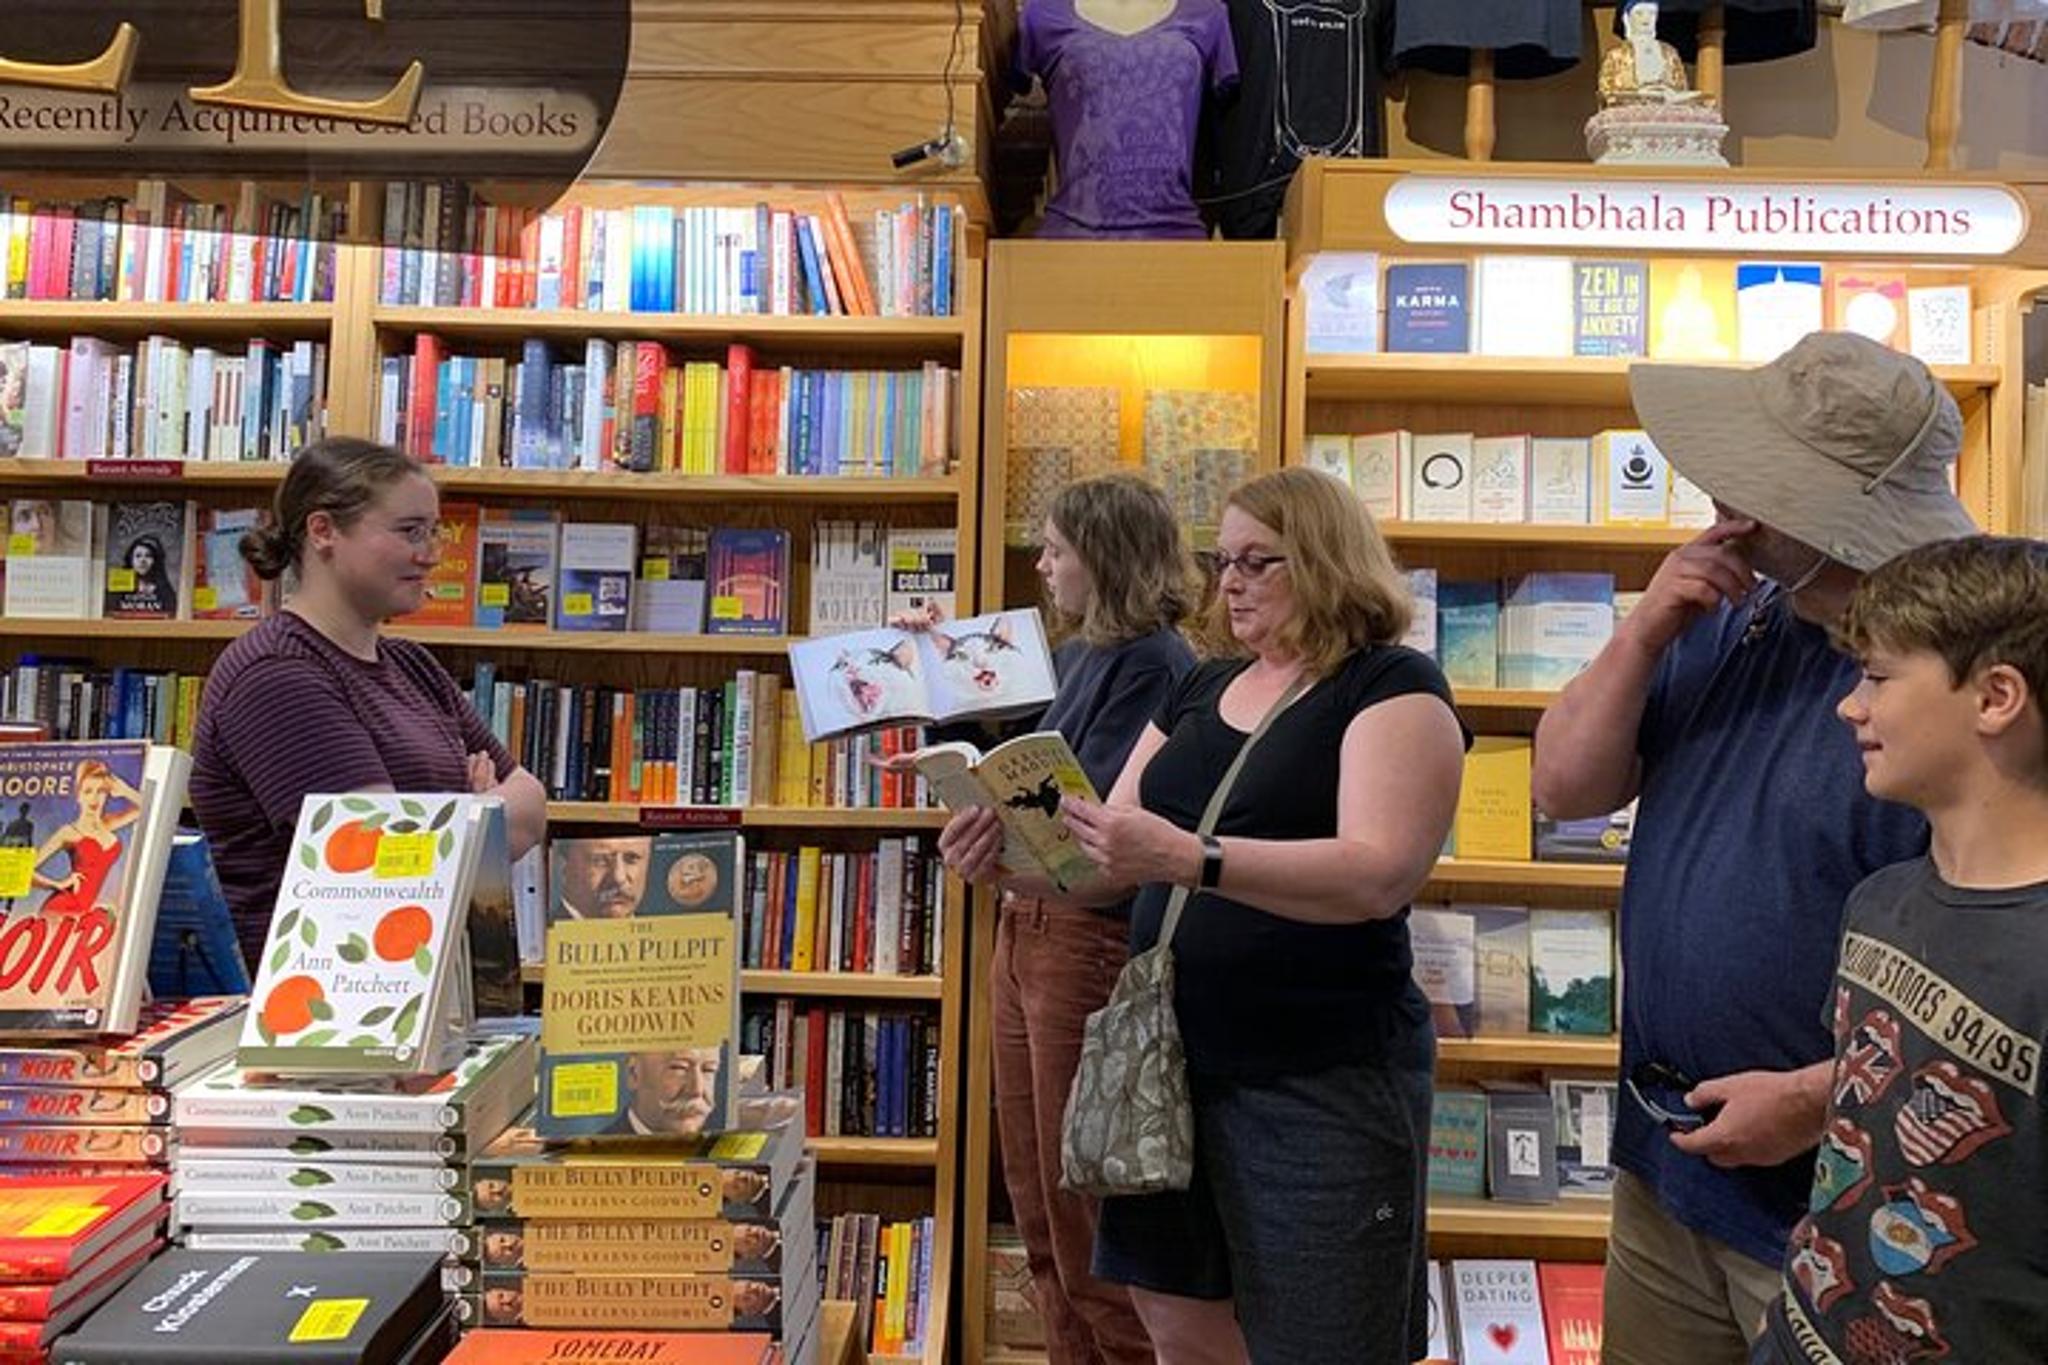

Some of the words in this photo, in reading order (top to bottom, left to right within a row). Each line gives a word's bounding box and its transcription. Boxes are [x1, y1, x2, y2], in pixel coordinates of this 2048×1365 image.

[0, 96, 148, 142] Recently
[463, 103, 577, 135] Books
[1450, 190, 1686, 231] Shambhala
[1706, 196, 1971, 236] Publications
[1581, 267, 1619, 296] ZEN
[1395, 295, 1459, 308] KARMA
[1582, 315, 1639, 336] ANXIETY
[0, 776, 74, 797] OORE
[293, 880, 445, 900] Commonwealth
[0, 906, 116, 995] OIR
[557, 940, 630, 965] BULLY
[638, 936, 725, 961] PULPIT
[292, 952, 334, 971] Ann
[331, 973, 411, 994] Patchett
[551, 987, 624, 1012] DORIS
[629, 983, 725, 1009] KEARNS
[576, 1010, 695, 1036] GOODWIN
[1878, 954, 1947, 1025] STONES
[1944, 1004, 2036, 1083] 94/95
[21, 1057, 76, 1080] NOIR
[26, 1092, 83, 1116] NOIR
[345, 1105, 369, 1119] Ann
[372, 1105, 419, 1120] Patchett
[24, 1132, 80, 1155] NOIR
[345, 1169, 369, 1182] Ann
[372, 1169, 419, 1183] Patchett
[523, 1170, 559, 1187] THE
[563, 1169, 623, 1187] BULLY
[629, 1167, 701, 1187] PULPIT
[348, 1202, 371, 1215] Ann
[374, 1202, 422, 1216] Patchett
[571, 1196, 628, 1207] KEARNS
[630, 1195, 699, 1207] GOODWIN
[535, 1226, 571, 1241] THE
[576, 1224, 635, 1241] BULLY
[641, 1222, 712, 1242] PULPIT
[533, 1280, 570, 1297] THE
[575, 1278, 635, 1297] BULLY
[641, 1276, 712, 1298] PULPIT
[1461, 1270, 1531, 1286] DEEPER
[1463, 1288, 1532, 1304] DATING
[547, 1338, 667, 1360] SOMEDAY
